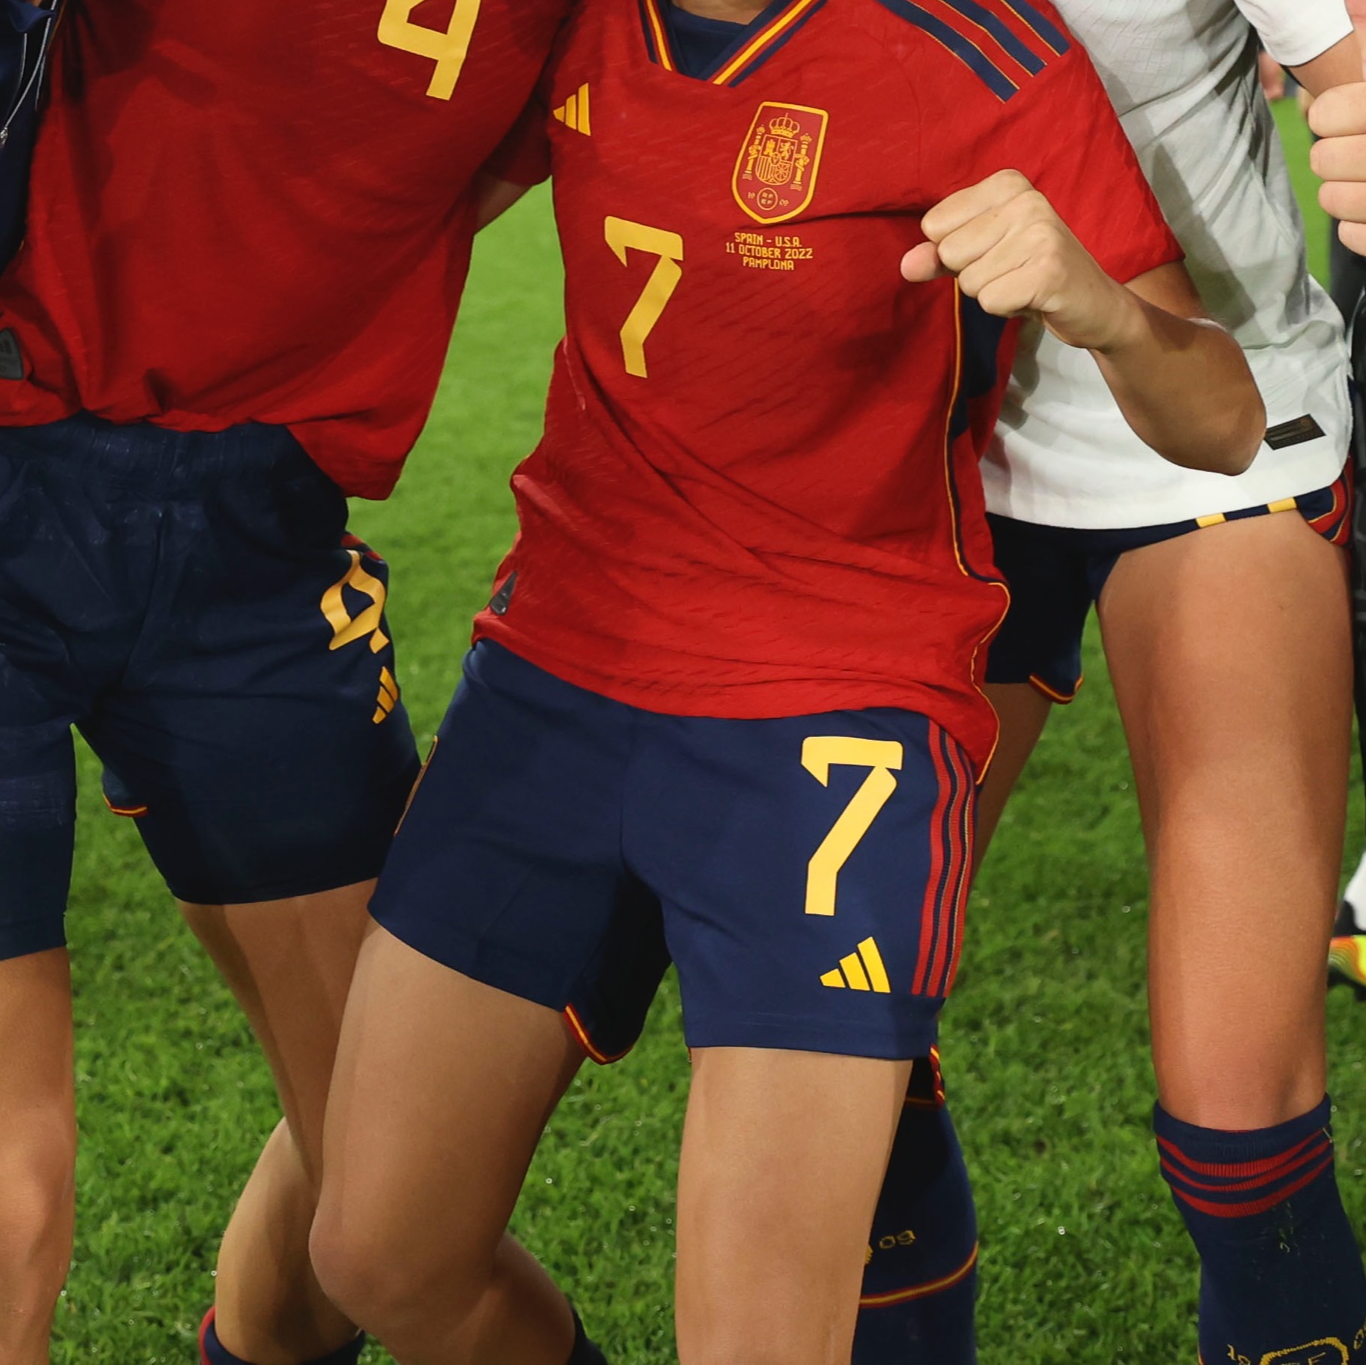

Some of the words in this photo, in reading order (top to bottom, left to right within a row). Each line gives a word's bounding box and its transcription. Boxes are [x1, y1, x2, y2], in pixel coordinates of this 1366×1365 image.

[734, 232, 764, 246] SPAIN
[725, 242, 736, 253] 11
[738, 244, 781, 258] OCTOBER
[784, 248, 814, 259] 2022
[742, 256, 794, 270] PAMPLONA
[604, 215, 684, 379] 7
[801, 736, 903, 917] 7
